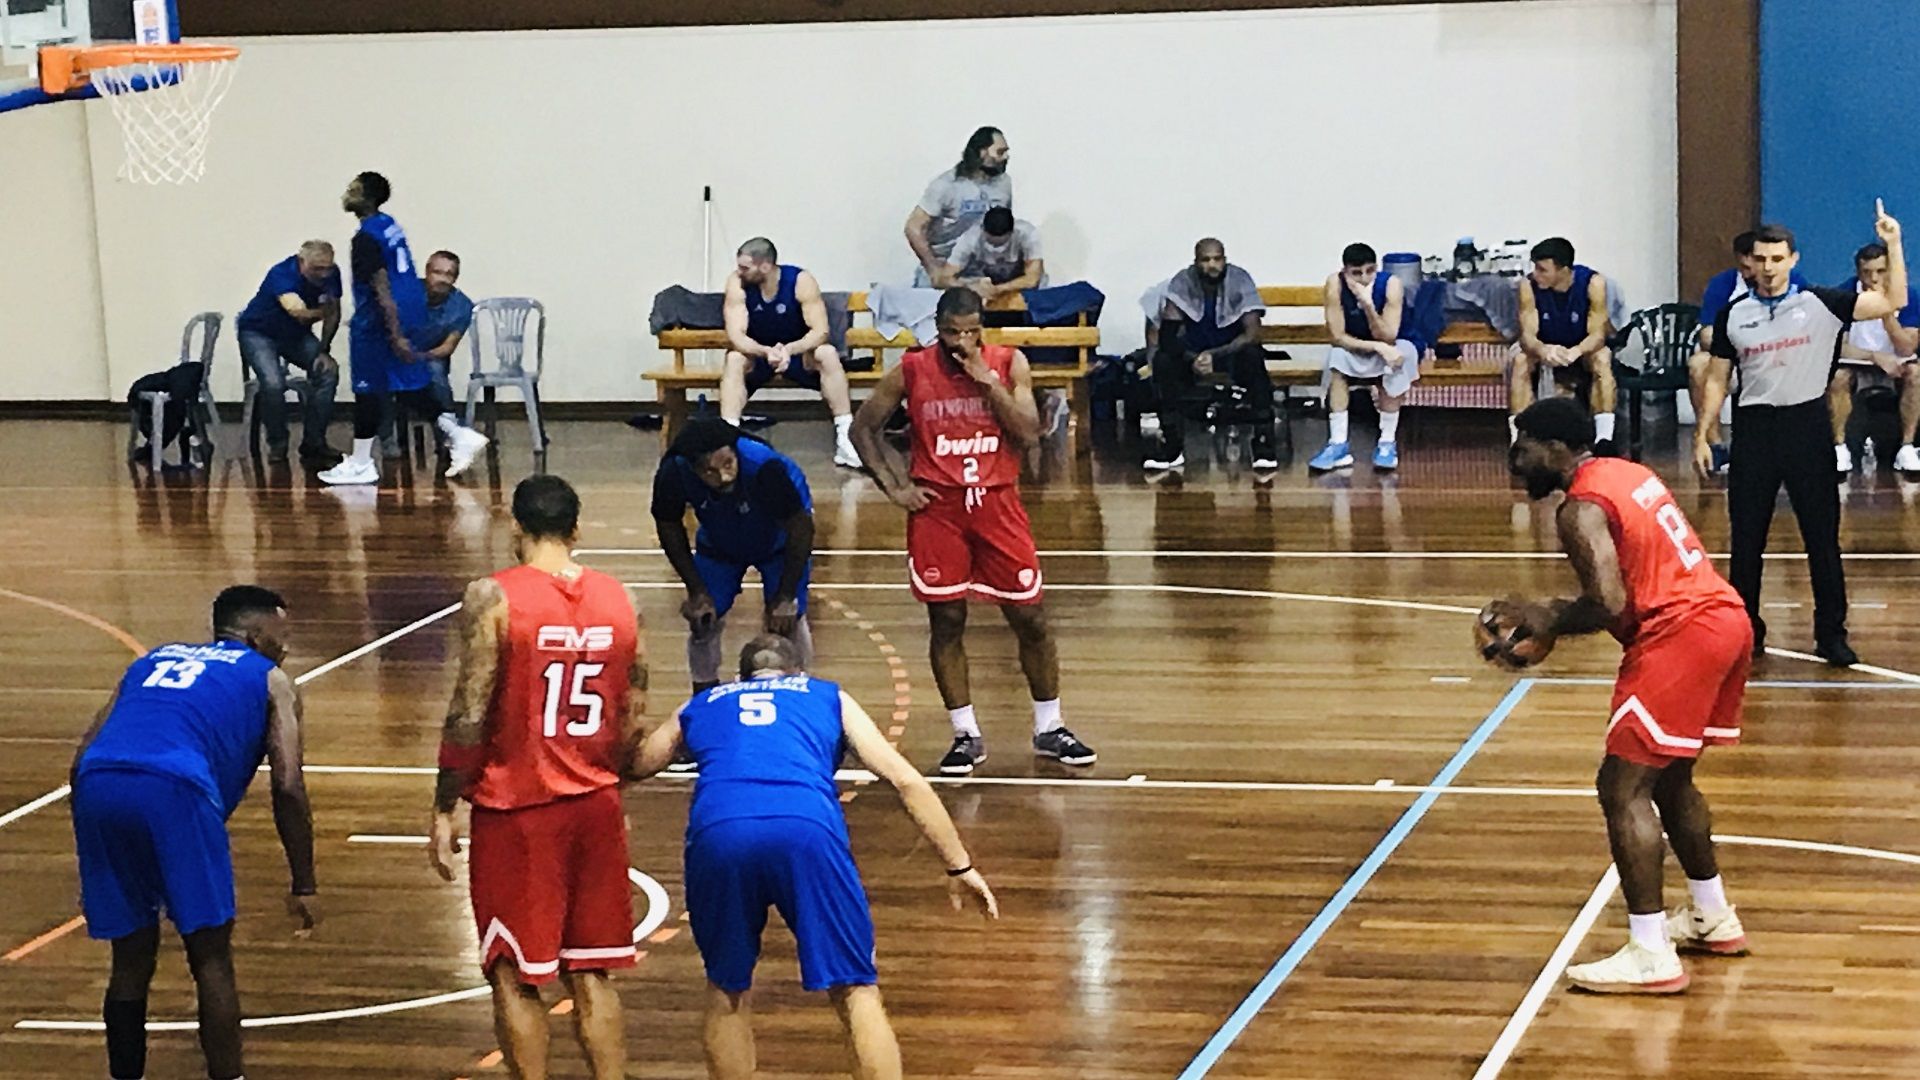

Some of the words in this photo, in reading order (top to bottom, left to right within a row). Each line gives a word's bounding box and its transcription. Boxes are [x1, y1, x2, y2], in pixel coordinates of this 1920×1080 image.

[936, 431, 999, 456] bwin
[963, 457, 980, 483] 2
[142, 660, 207, 689] 13
[543, 662, 604, 737] 15
[739, 692, 777, 726] 5
